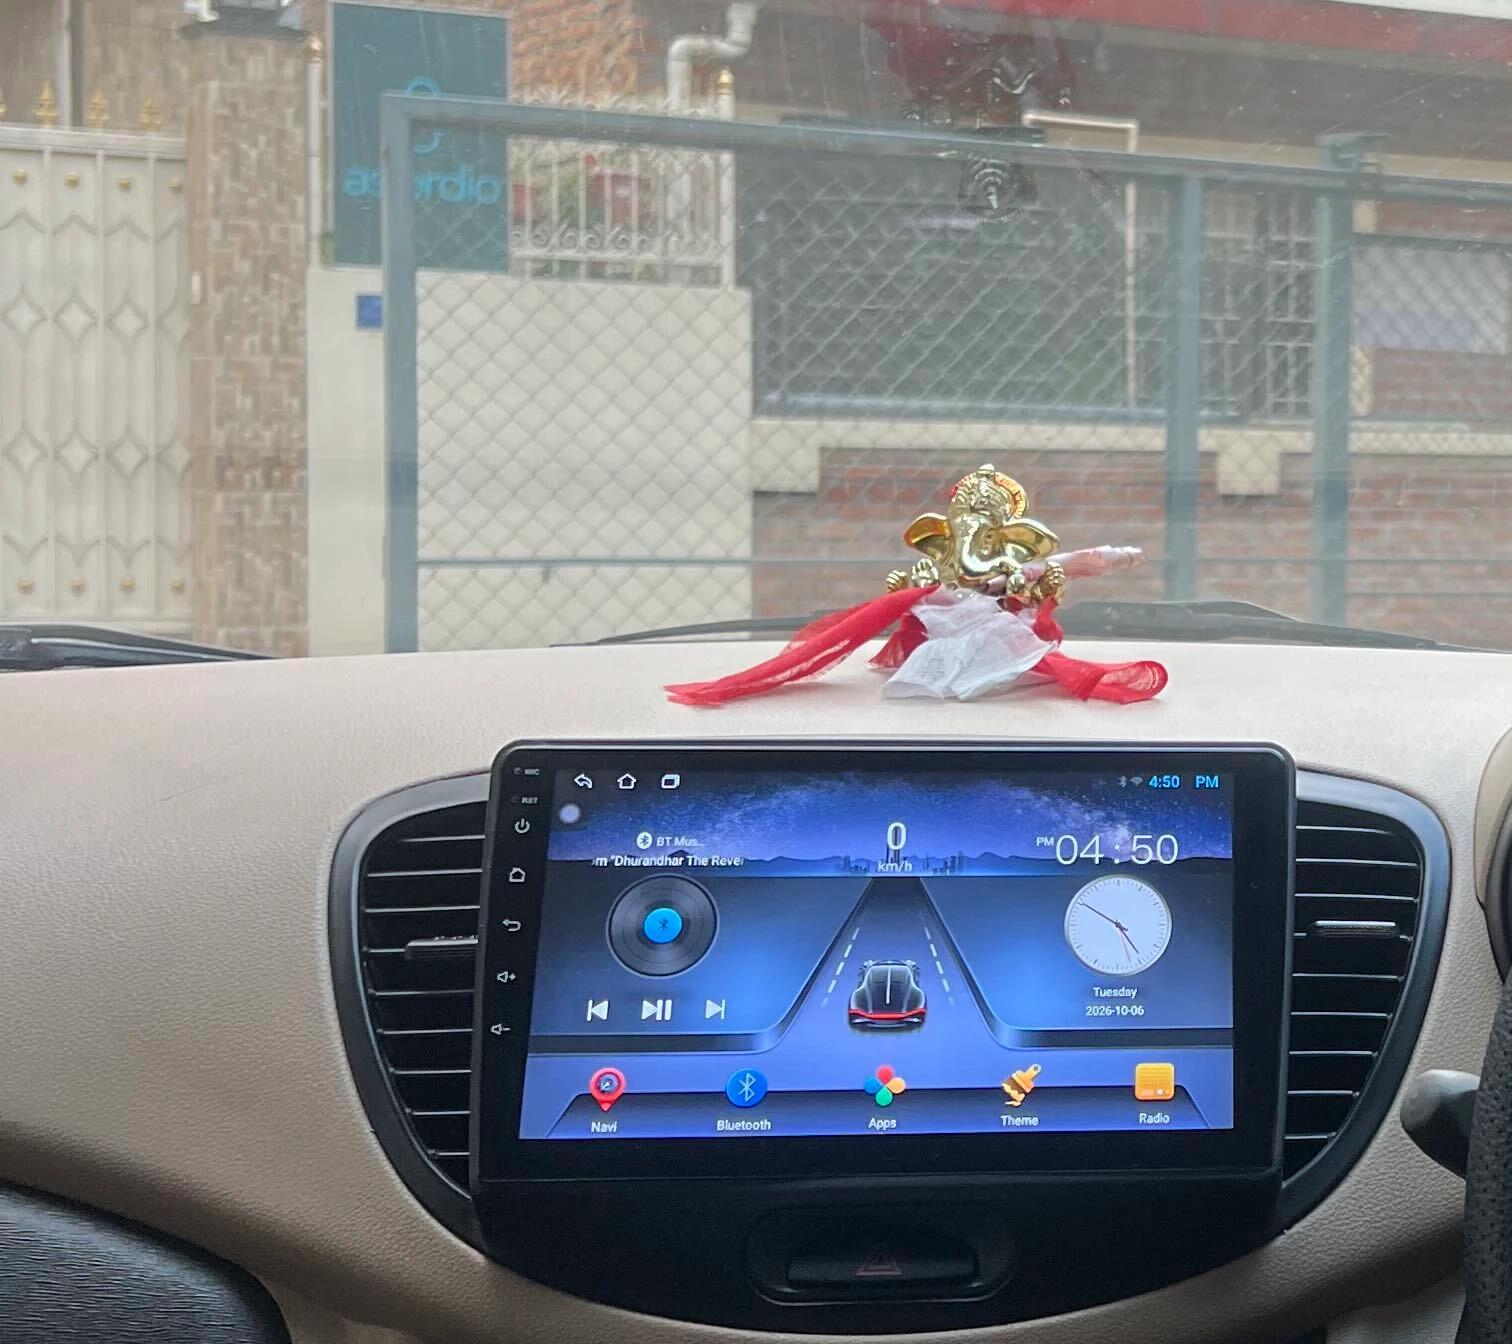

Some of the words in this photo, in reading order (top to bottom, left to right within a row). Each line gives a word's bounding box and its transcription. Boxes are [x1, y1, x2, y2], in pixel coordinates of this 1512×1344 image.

[1149, 776, 1180, 788] 4:50
[1195, 776, 1219, 788] PM
[656, 836, 671, 847] BT
[887, 822, 907, 851] 0
[1036, 836, 1054, 847] PM
[687, 856, 708, 867] The
[877, 860, 913, 873] km/h
[1093, 987, 1138, 999] Tuesday
[1085, 1005, 1145, 1016] 2026-10-06
[868, 1117, 897, 1130] Apps
[1000, 1115, 1039, 1126] Theme
[1139, 1112, 1170, 1124] Radio
[591, 1121, 618, 1133] Navi
[716, 1119, 772, 1131] Bluetooth
